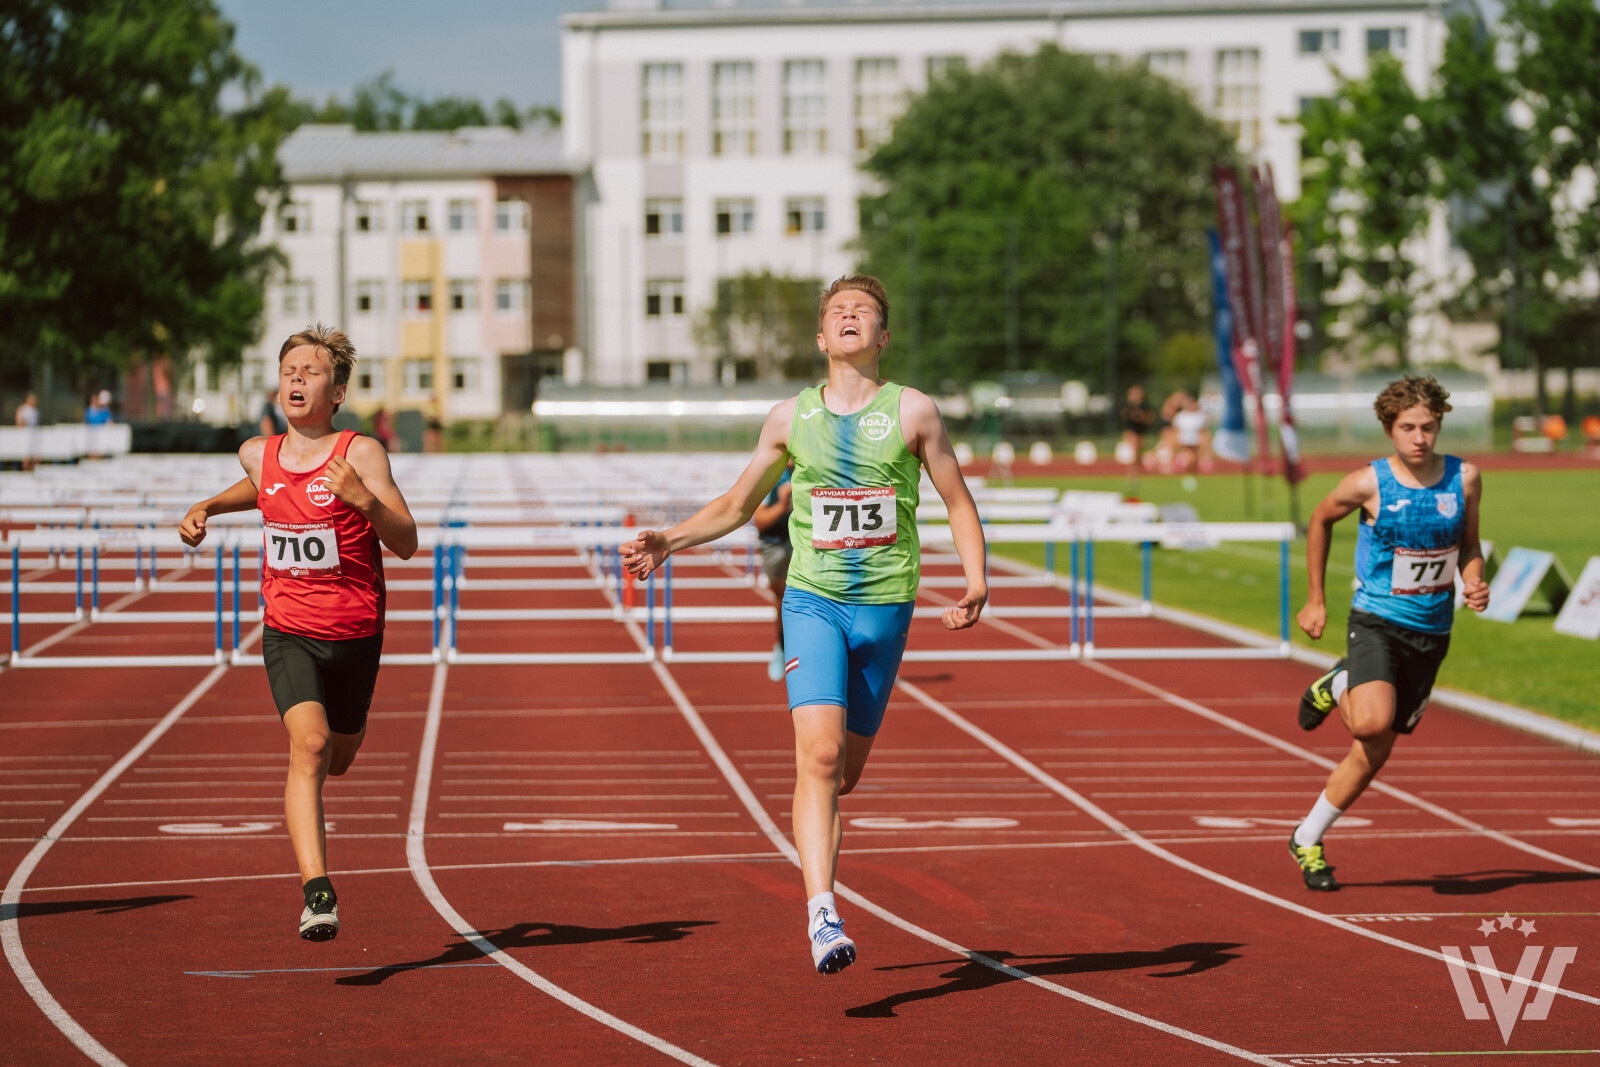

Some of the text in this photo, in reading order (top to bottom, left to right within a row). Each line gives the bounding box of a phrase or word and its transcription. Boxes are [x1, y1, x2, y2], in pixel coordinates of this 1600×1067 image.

[306, 484, 330, 493] ĀDA
[823, 503, 884, 532] 713
[271, 534, 326, 562] 710
[1411, 561, 1446, 581] 77
